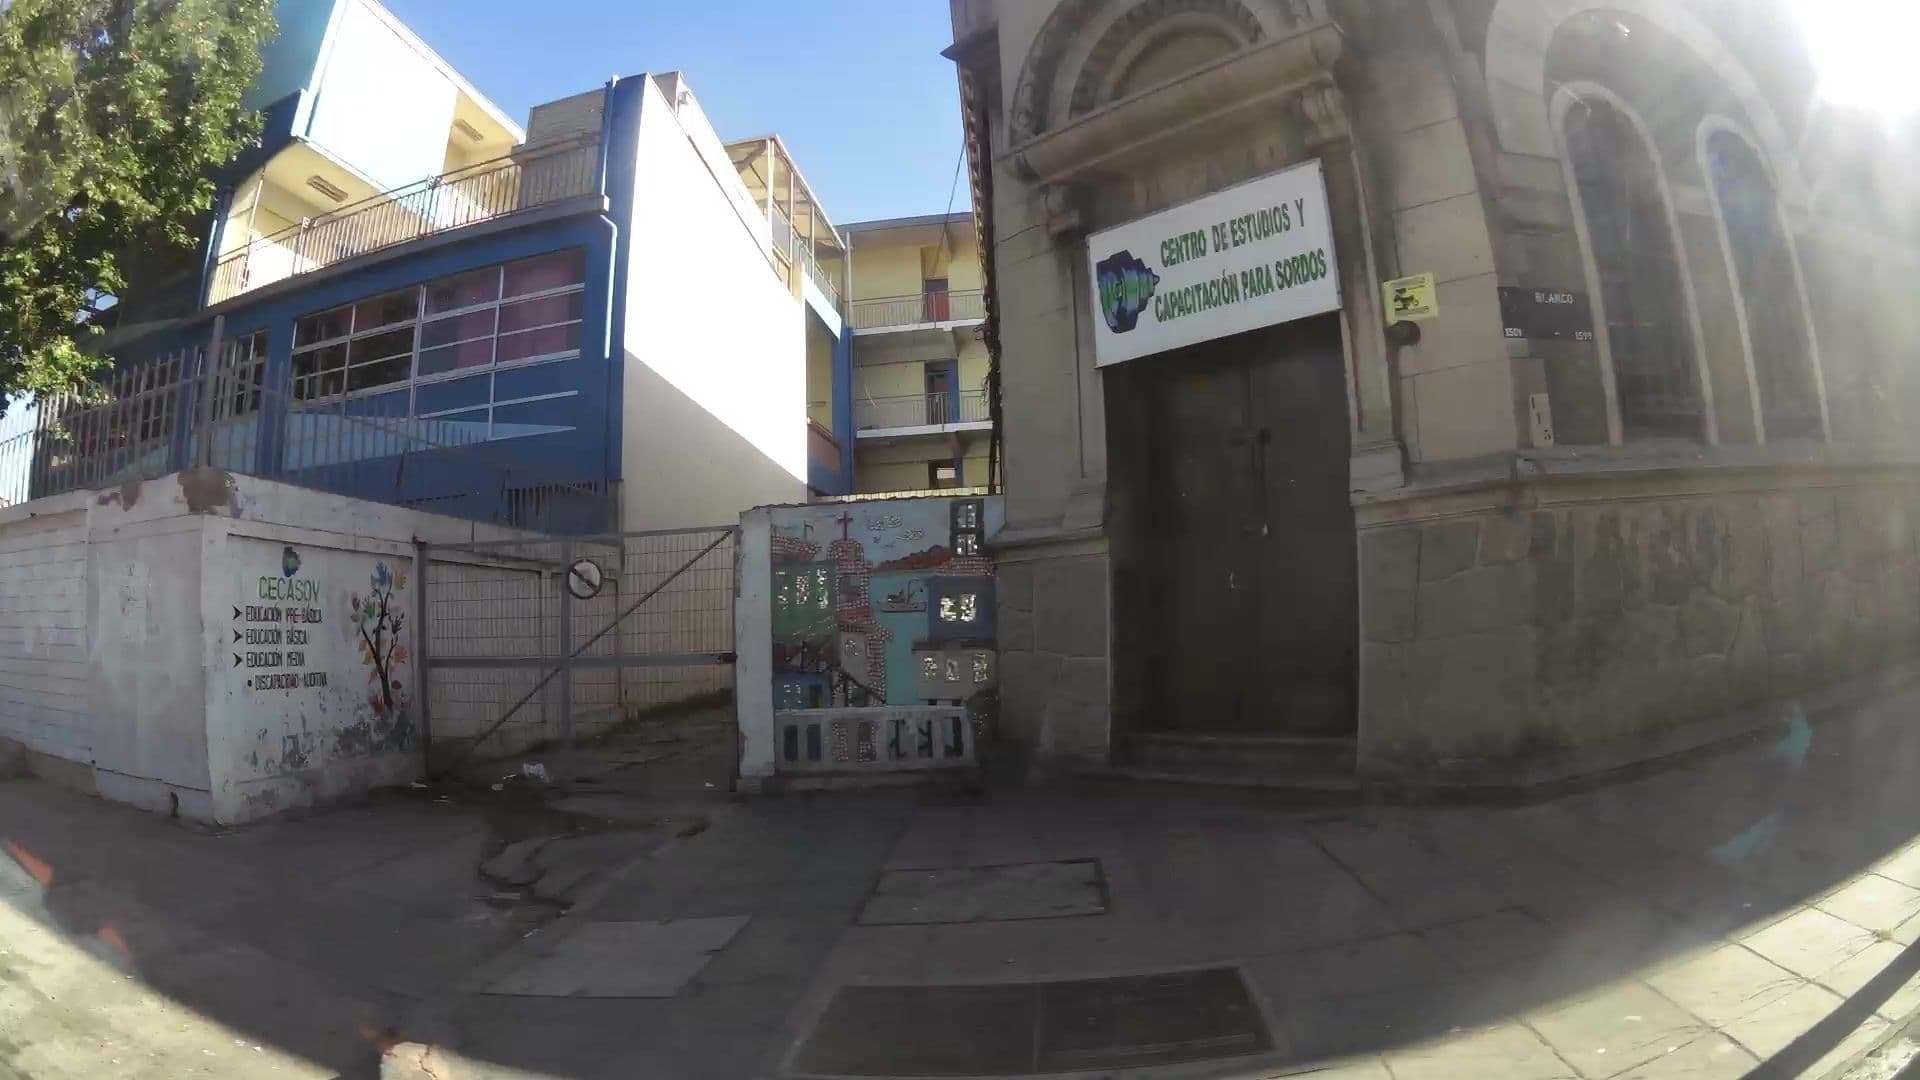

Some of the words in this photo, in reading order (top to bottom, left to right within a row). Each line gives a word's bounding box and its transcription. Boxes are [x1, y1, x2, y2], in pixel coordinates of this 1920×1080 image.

[1160, 229, 1207, 268] CENTRO
[1211, 222, 1229, 253] DE
[1230, 203, 1291, 247] ESTUDIOS
[1294, 198, 1305, 227] Y
[1155, 269, 1239, 323] CAPACITACIÓN
[1241, 264, 1275, 299] PARA
[1275, 248, 1327, 291] SORDOS
[1535, 292, 1574, 305] BLANCO
[245, 603, 282, 622] EDUCACIÓN
[245, 625, 282, 645] EDUCACIÓN
[246, 649, 283, 668] EDUCACIÓN
